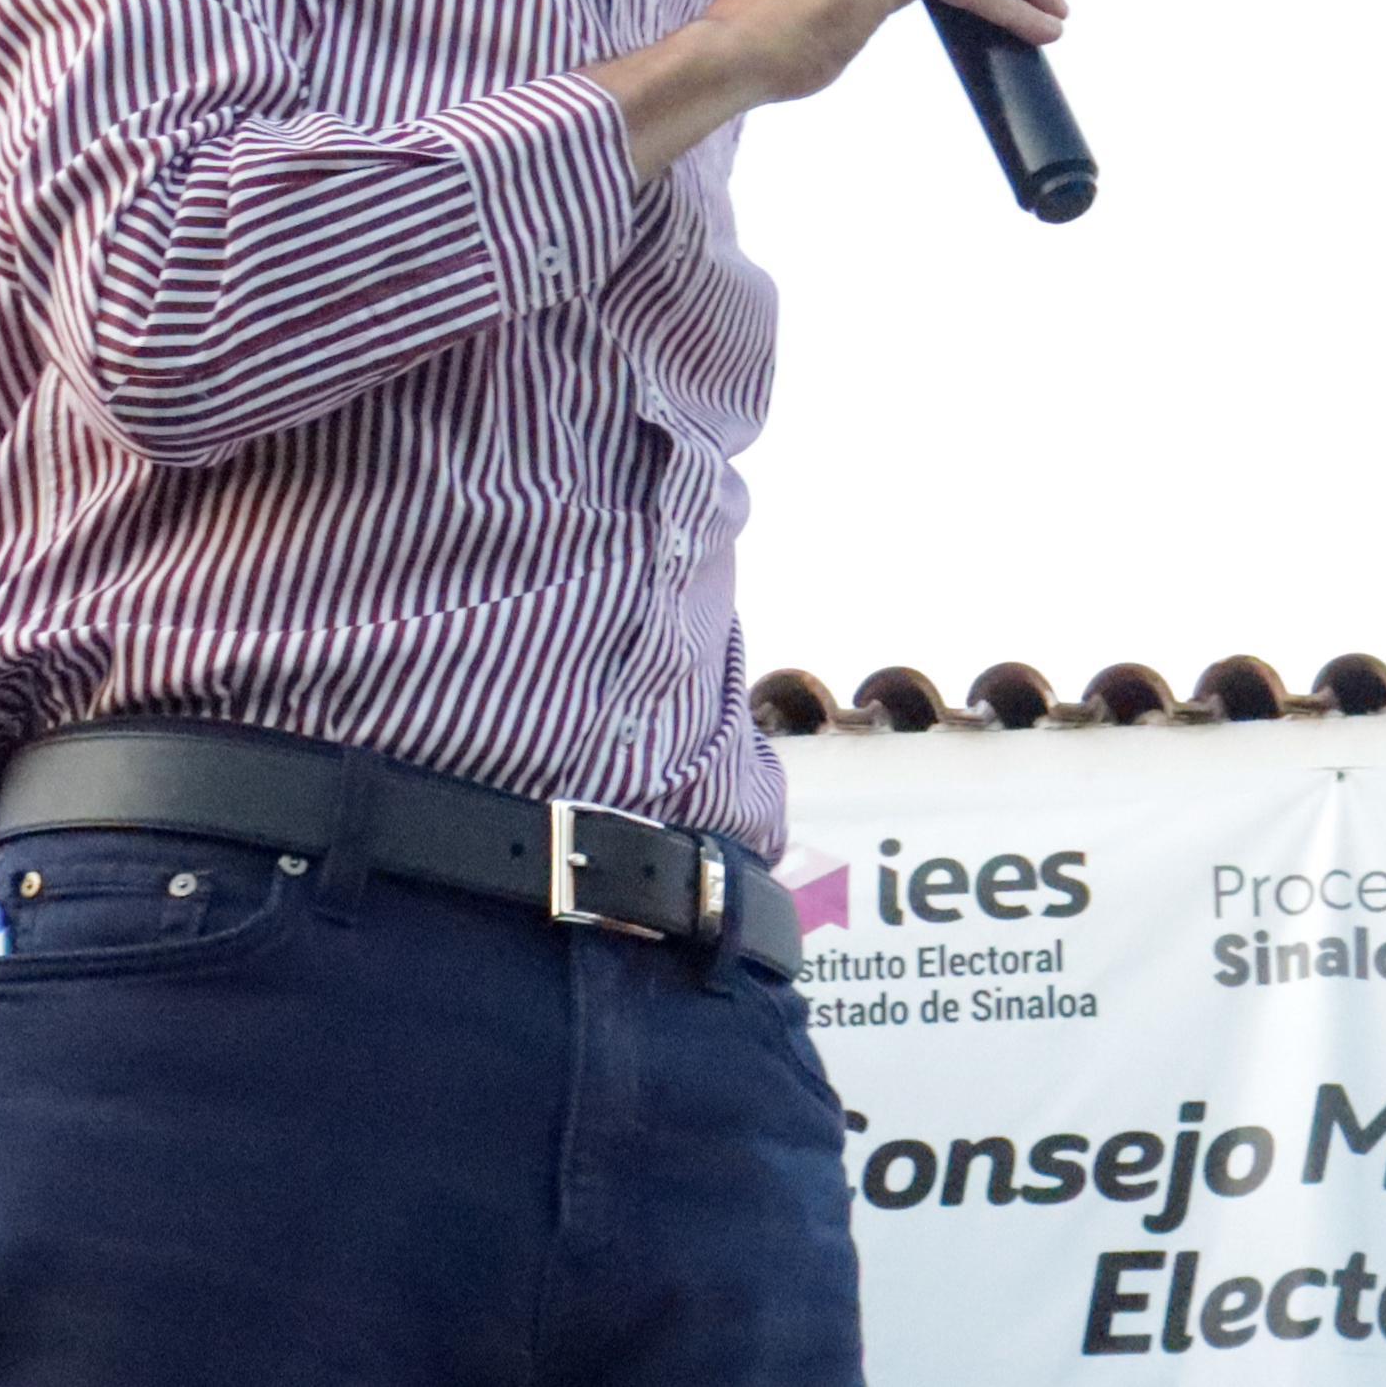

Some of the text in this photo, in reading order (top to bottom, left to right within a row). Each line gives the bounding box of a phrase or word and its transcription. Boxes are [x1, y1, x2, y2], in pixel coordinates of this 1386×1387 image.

[877, 838, 1092, 926] iees
[917, 939, 1064, 979] Electoral
[919, 989, 960, 1024] de
[971, 984, 1098, 1022] Sinaloa
